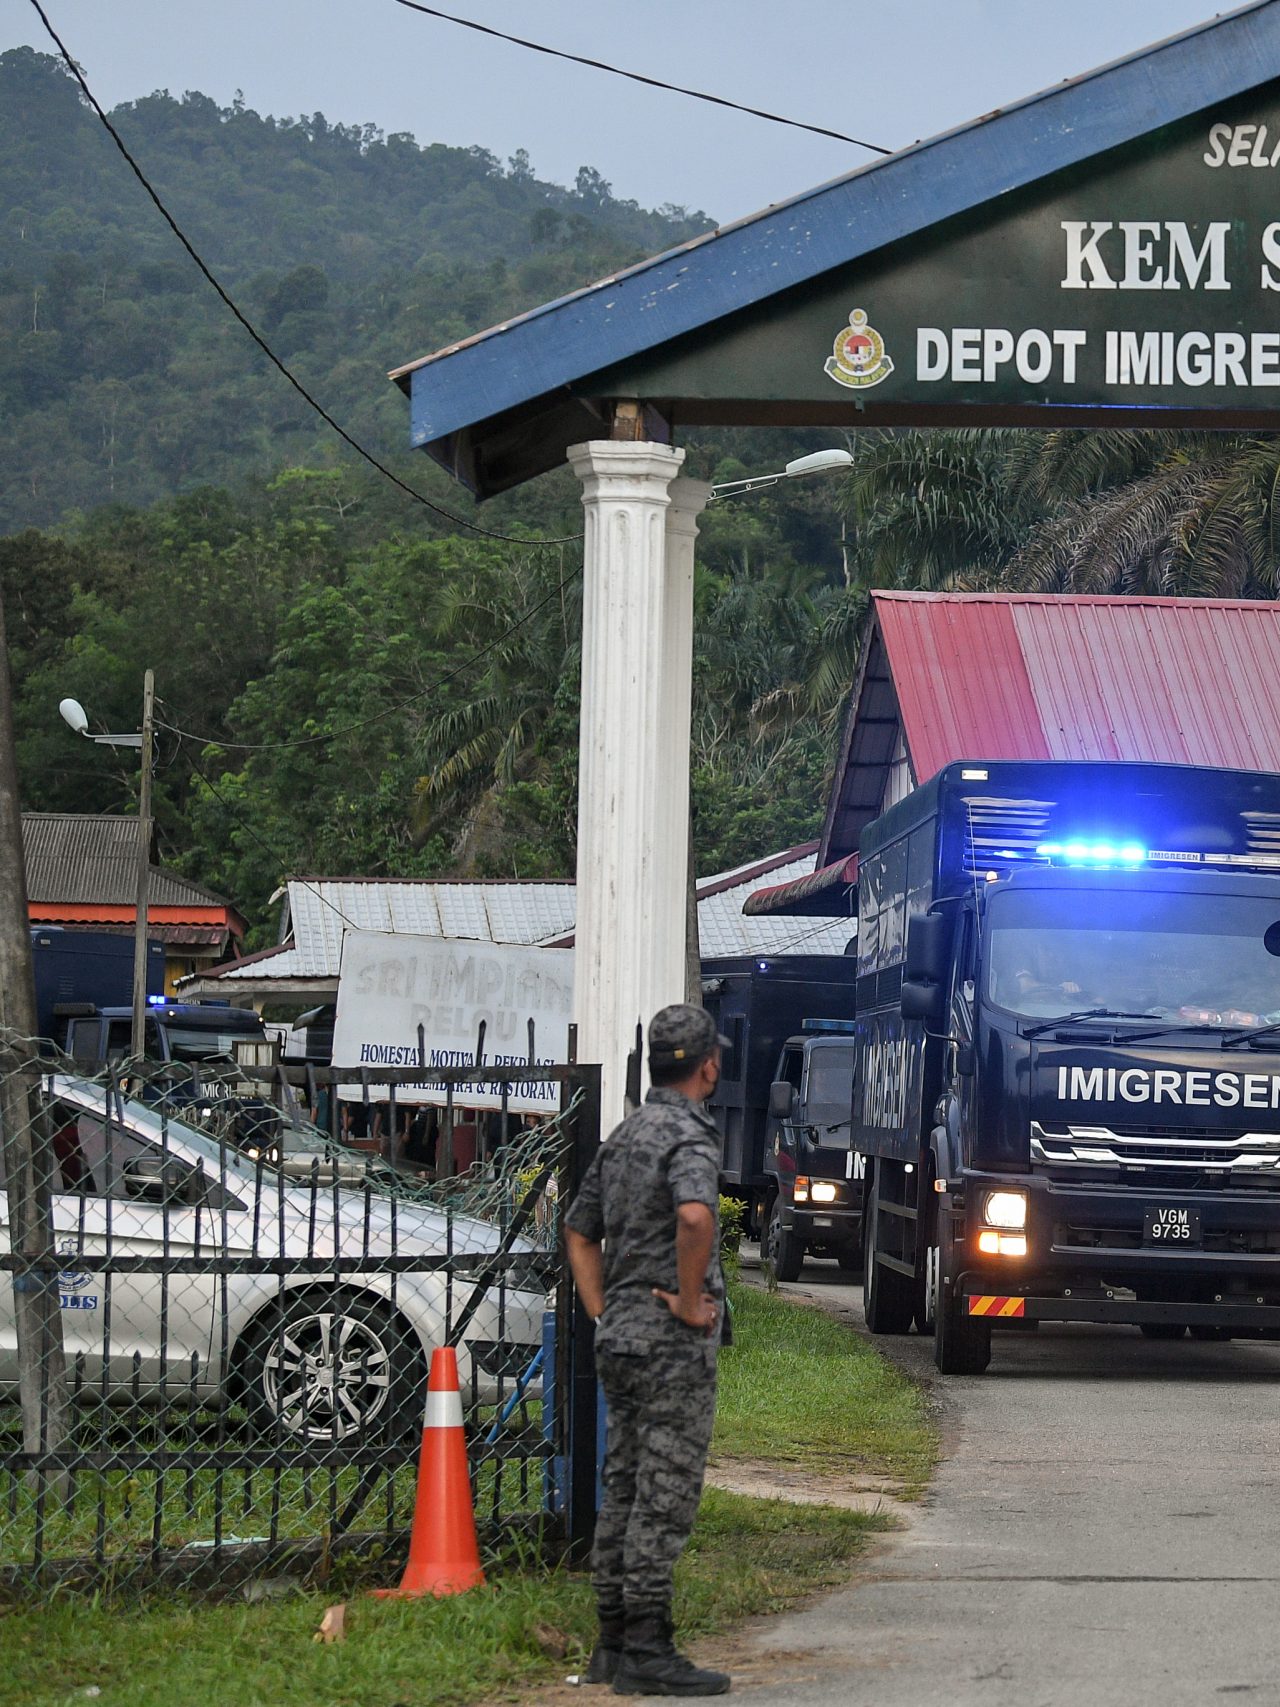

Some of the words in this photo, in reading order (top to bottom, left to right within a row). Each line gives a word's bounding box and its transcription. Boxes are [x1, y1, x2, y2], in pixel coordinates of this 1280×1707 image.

[1061, 221, 1231, 290] KEM
[916, 327, 1086, 383] DEPOT
[429, 1050, 488, 1068] MOTIVAI
[1158, 1209, 1187, 1224] VGM
[1152, 1225, 1190, 1239] 9735
[59, 1296, 97, 1309] LIS
